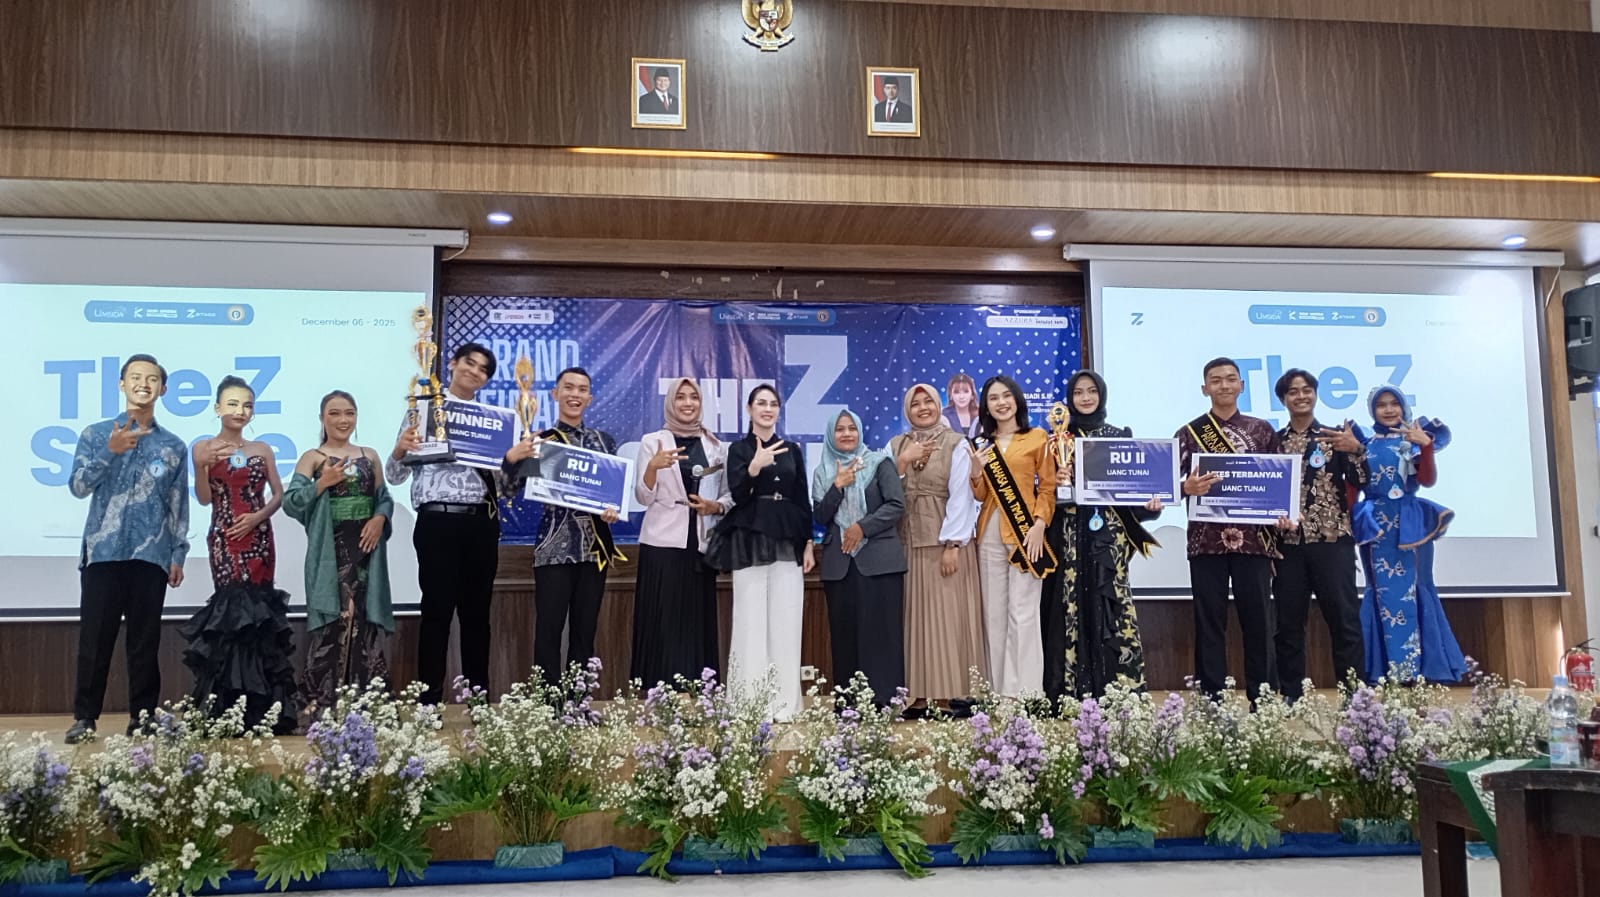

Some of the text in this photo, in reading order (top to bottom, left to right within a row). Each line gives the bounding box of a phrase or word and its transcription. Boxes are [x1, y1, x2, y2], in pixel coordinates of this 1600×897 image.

[302, 318, 349, 326] December
[352, 318, 364, 326] 06
[373, 318, 397, 326] 2025
[234, 356, 281, 414] Z
[784, 335, 849, 434] Z
[1374, 354, 1416, 408] Z
[449, 428, 492, 440] UANG TUNAI
[567, 458, 598, 474] RU I
[1110, 451, 1146, 464] RU II
[559, 472, 602, 486] UANG TUNAI
[989, 460, 1009, 488] BAHASA
[1207, 470, 1283, 479] KES TERBANYAK
[998, 485, 1016, 504] JAWA
[1009, 501, 1026, 525] TIMUR
